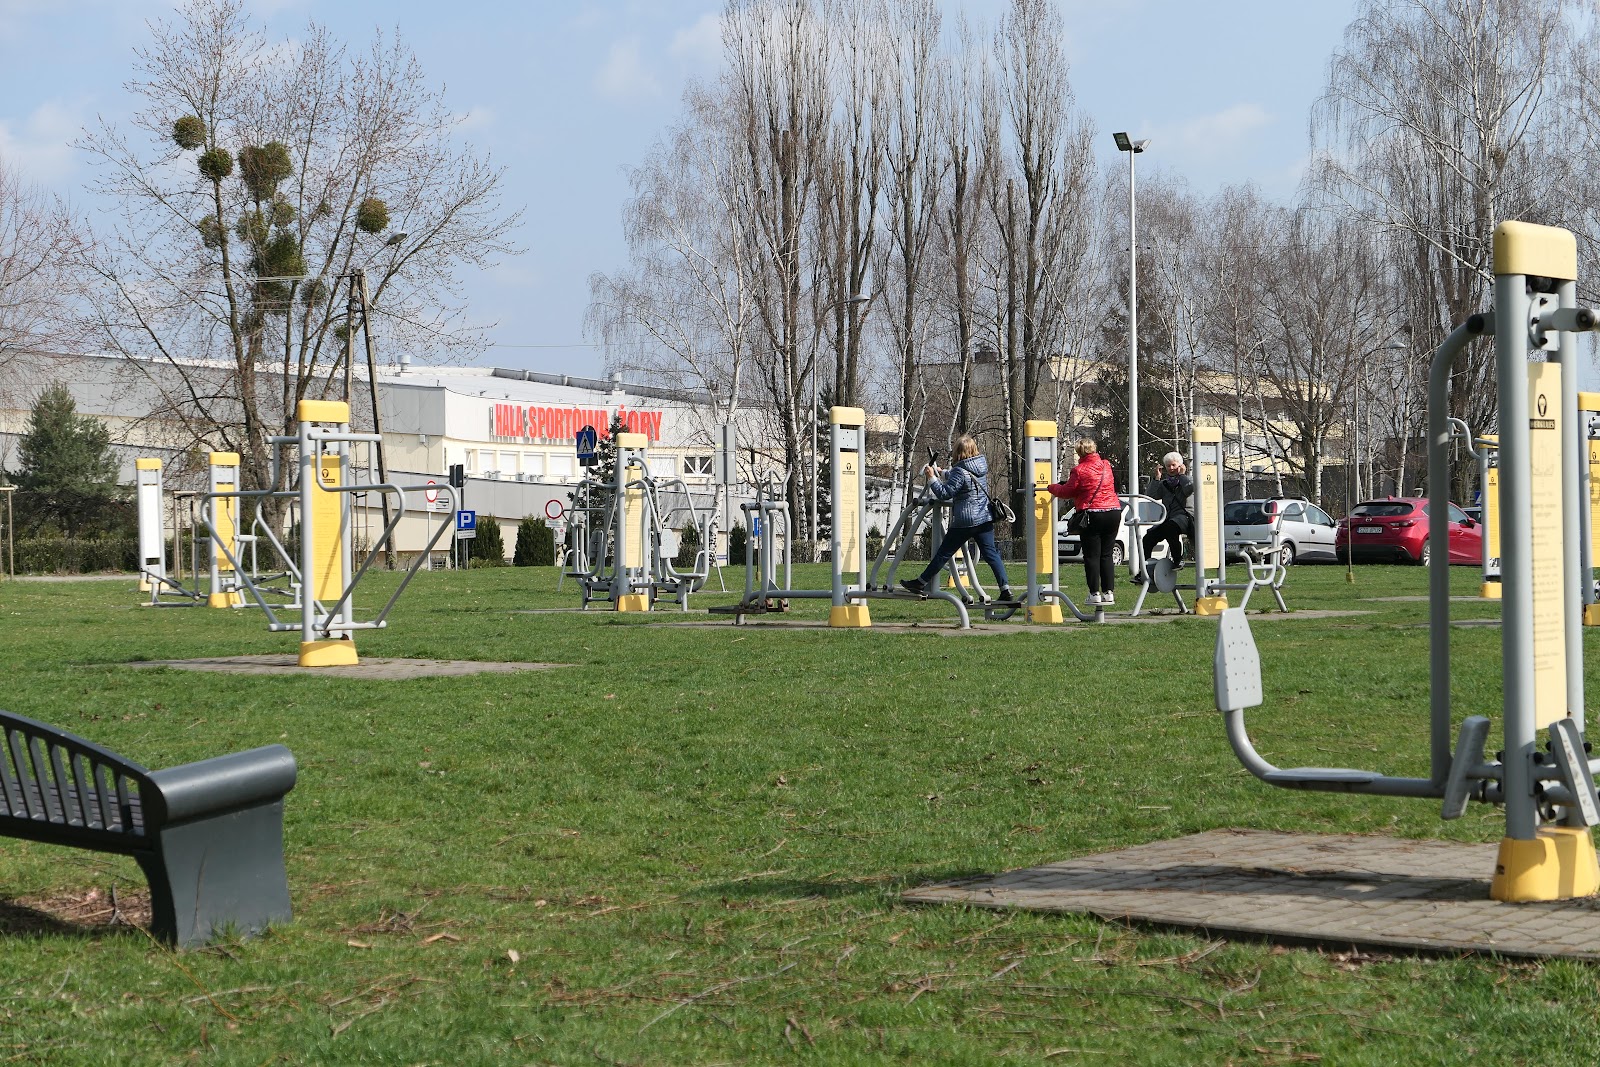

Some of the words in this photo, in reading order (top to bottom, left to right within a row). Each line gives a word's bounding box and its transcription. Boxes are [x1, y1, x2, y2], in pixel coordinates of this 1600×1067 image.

[495, 404, 524, 437] HALA
[528, 406, 610, 440] SPORTOWA
[461, 513, 471, 527] P
